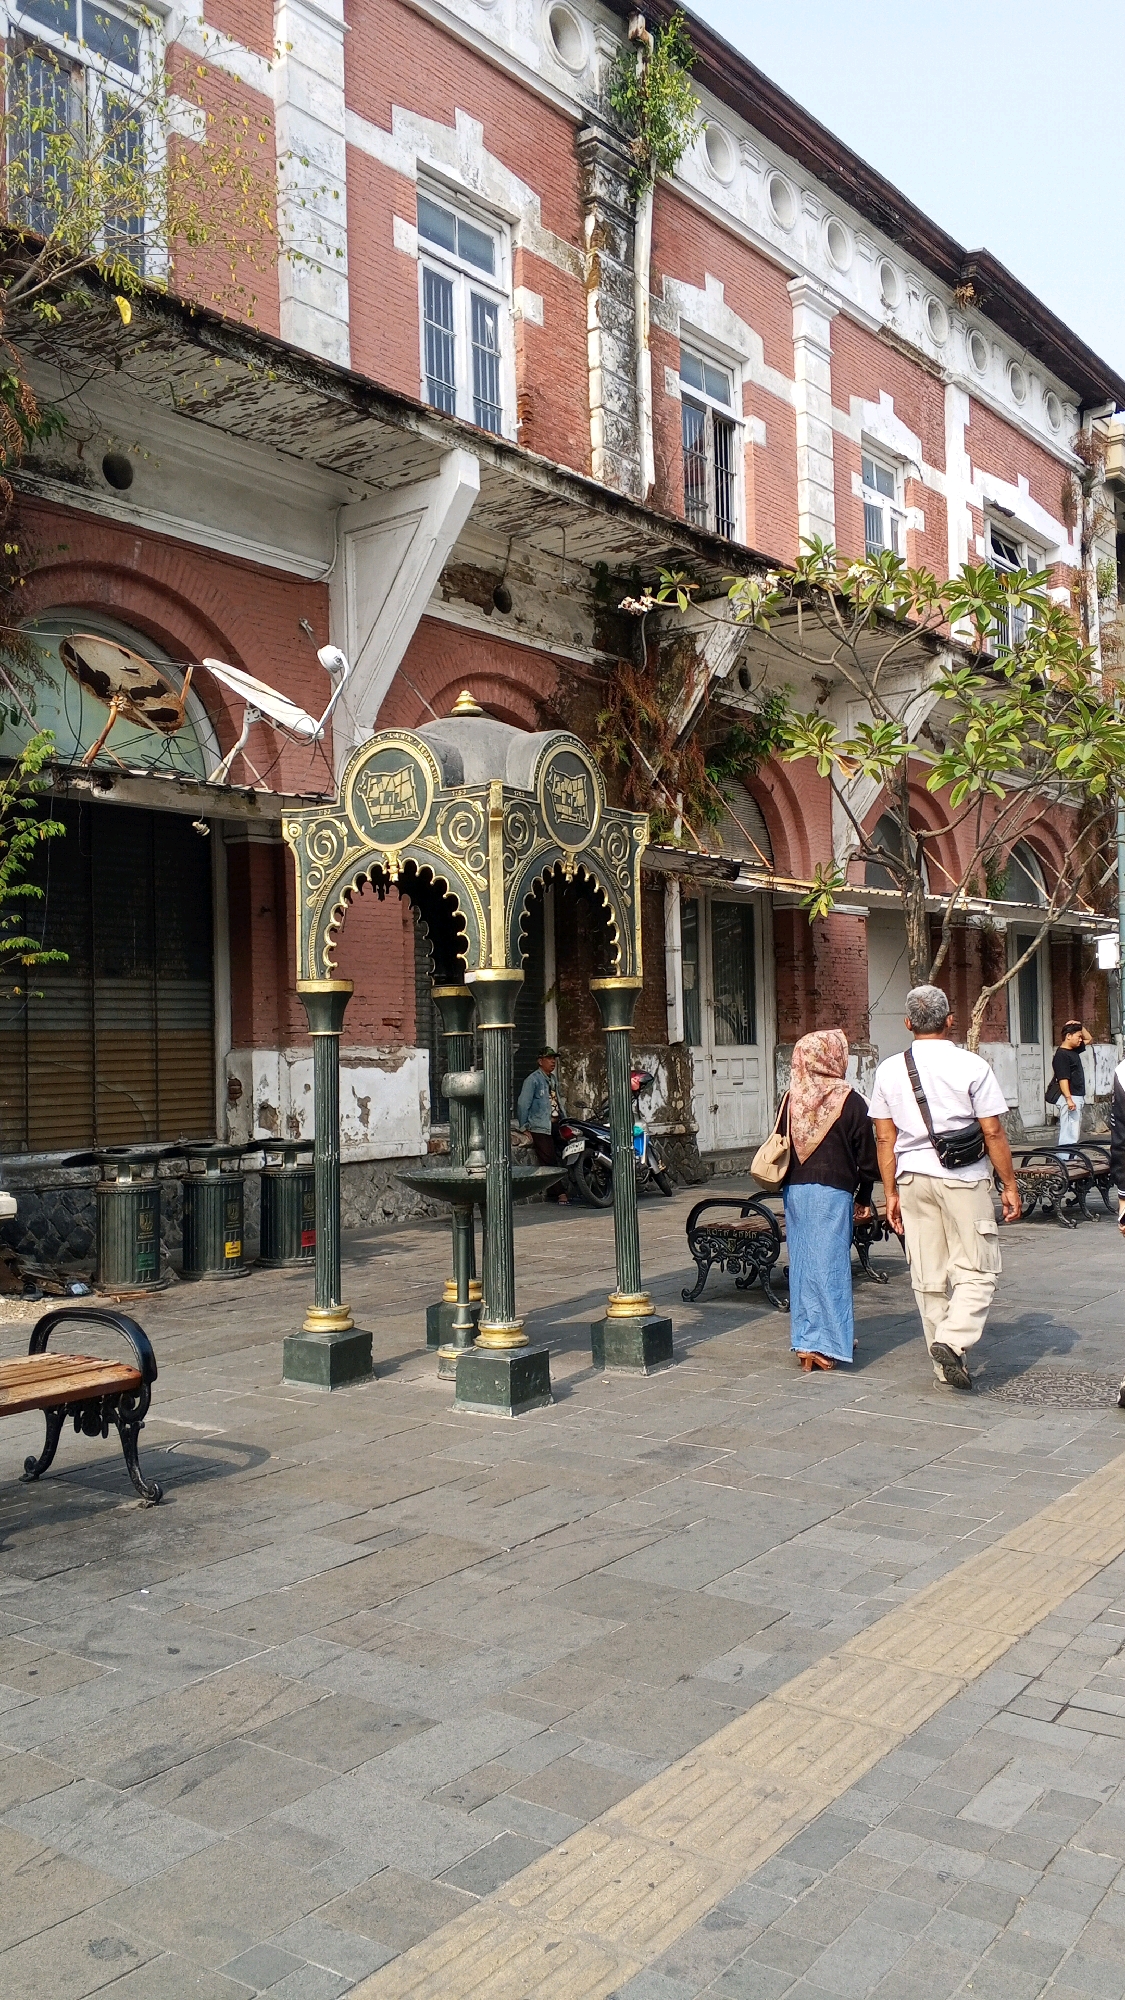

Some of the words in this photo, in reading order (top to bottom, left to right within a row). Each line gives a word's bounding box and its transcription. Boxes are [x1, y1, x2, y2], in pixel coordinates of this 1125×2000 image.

[340, 760, 356, 797] KAWASAN
[359, 736, 382, 754] KOTA
[388, 732, 413, 742] LAMA
[706, 1228, 730, 1236] KOTA
[732, 1230, 758, 1239] LAMA
